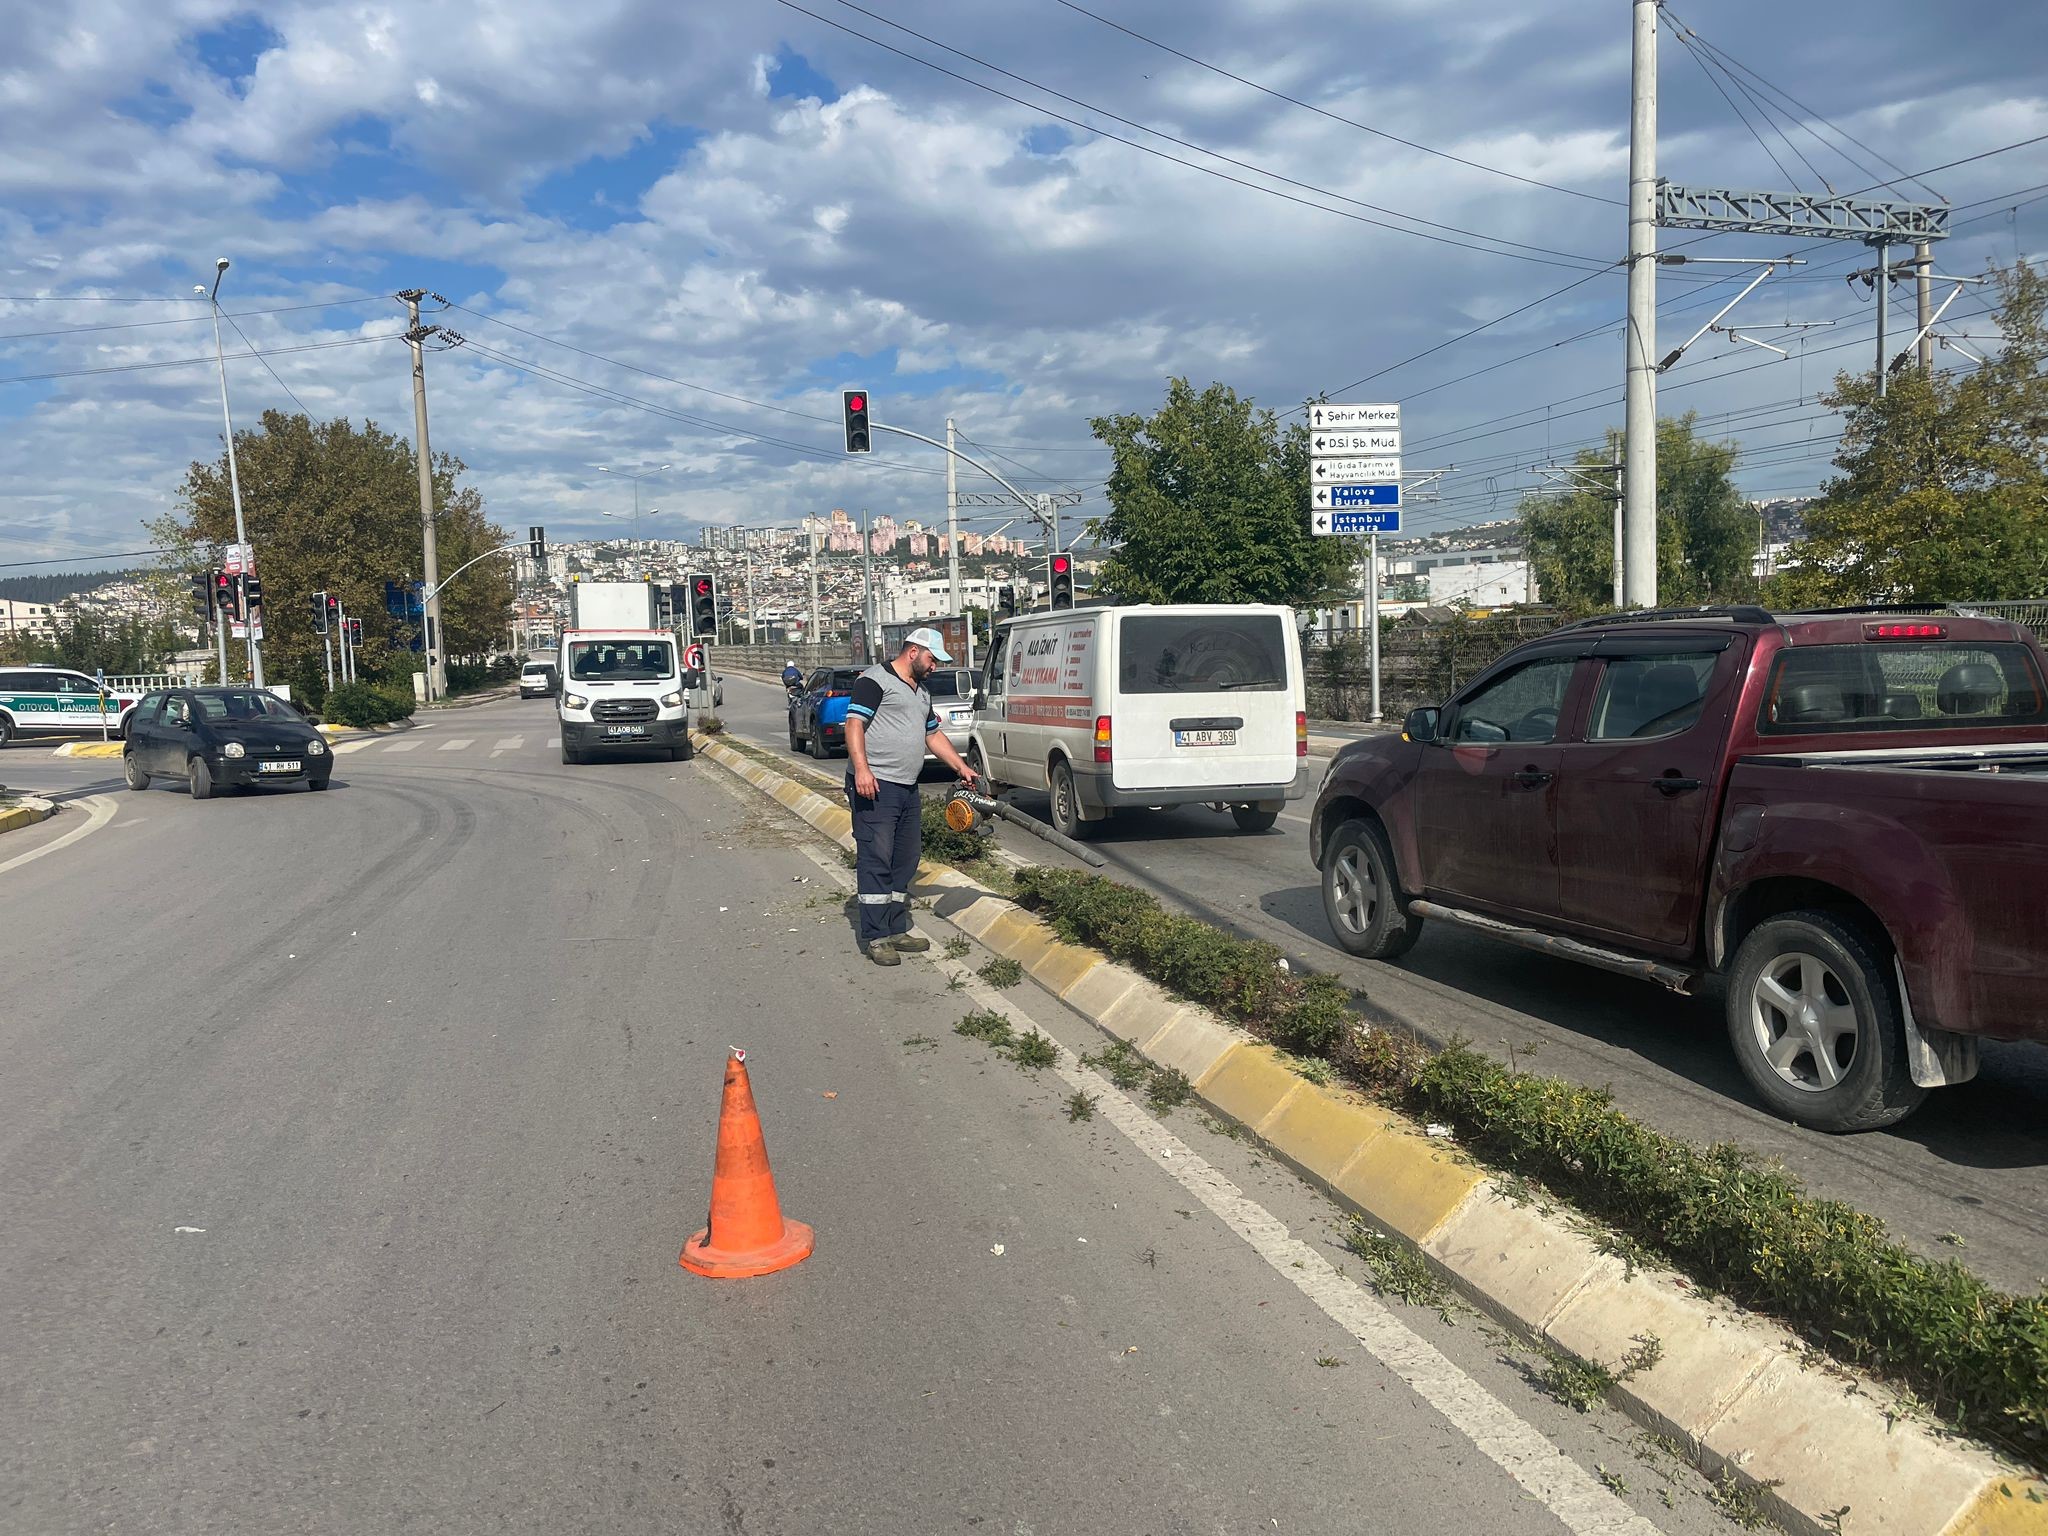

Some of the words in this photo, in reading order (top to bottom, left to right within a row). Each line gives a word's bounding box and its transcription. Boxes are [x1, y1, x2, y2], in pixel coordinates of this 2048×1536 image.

[1327, 411, 1355, 421] Şehir
[1352, 438, 1368, 449] Şb.
[1371, 438, 1396, 448] Müd.
[1335, 487, 1375, 496] Yalova
[1335, 497, 1370, 506] Bursa
[1334, 513, 1386, 523] İstanbul
[1335, 523, 1379, 533] Ankara
[19, 703, 55, 711] OTOYOL
[1181, 731, 1190, 742] 41
[1196, 731, 1212, 742] ABV
[1217, 730, 1233, 741] 369
[263, 762, 272, 770] 41
